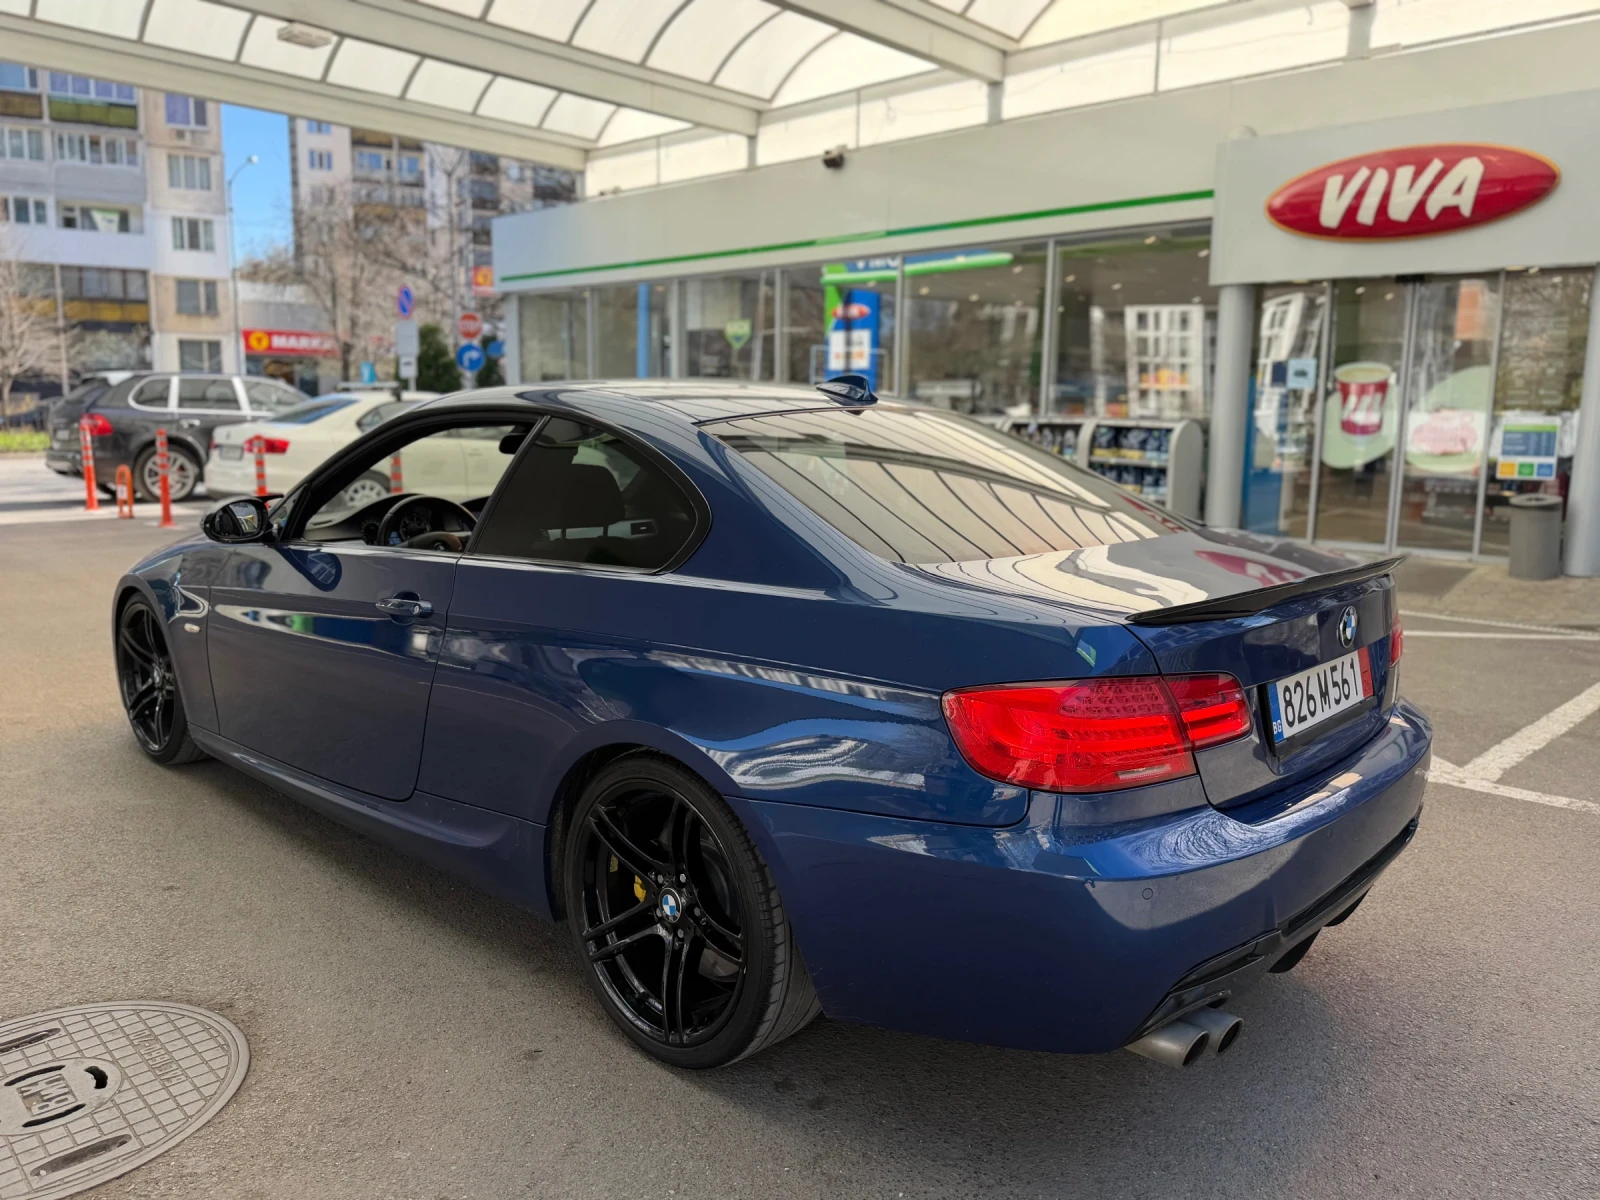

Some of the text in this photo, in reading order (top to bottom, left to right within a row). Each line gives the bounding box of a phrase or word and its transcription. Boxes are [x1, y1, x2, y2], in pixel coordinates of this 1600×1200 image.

[1319, 156, 1485, 229] VIVA
[1273, 720, 1282, 734] BG
[1283, 676, 1316, 728] 826
[1330, 657, 1358, 705] 561
